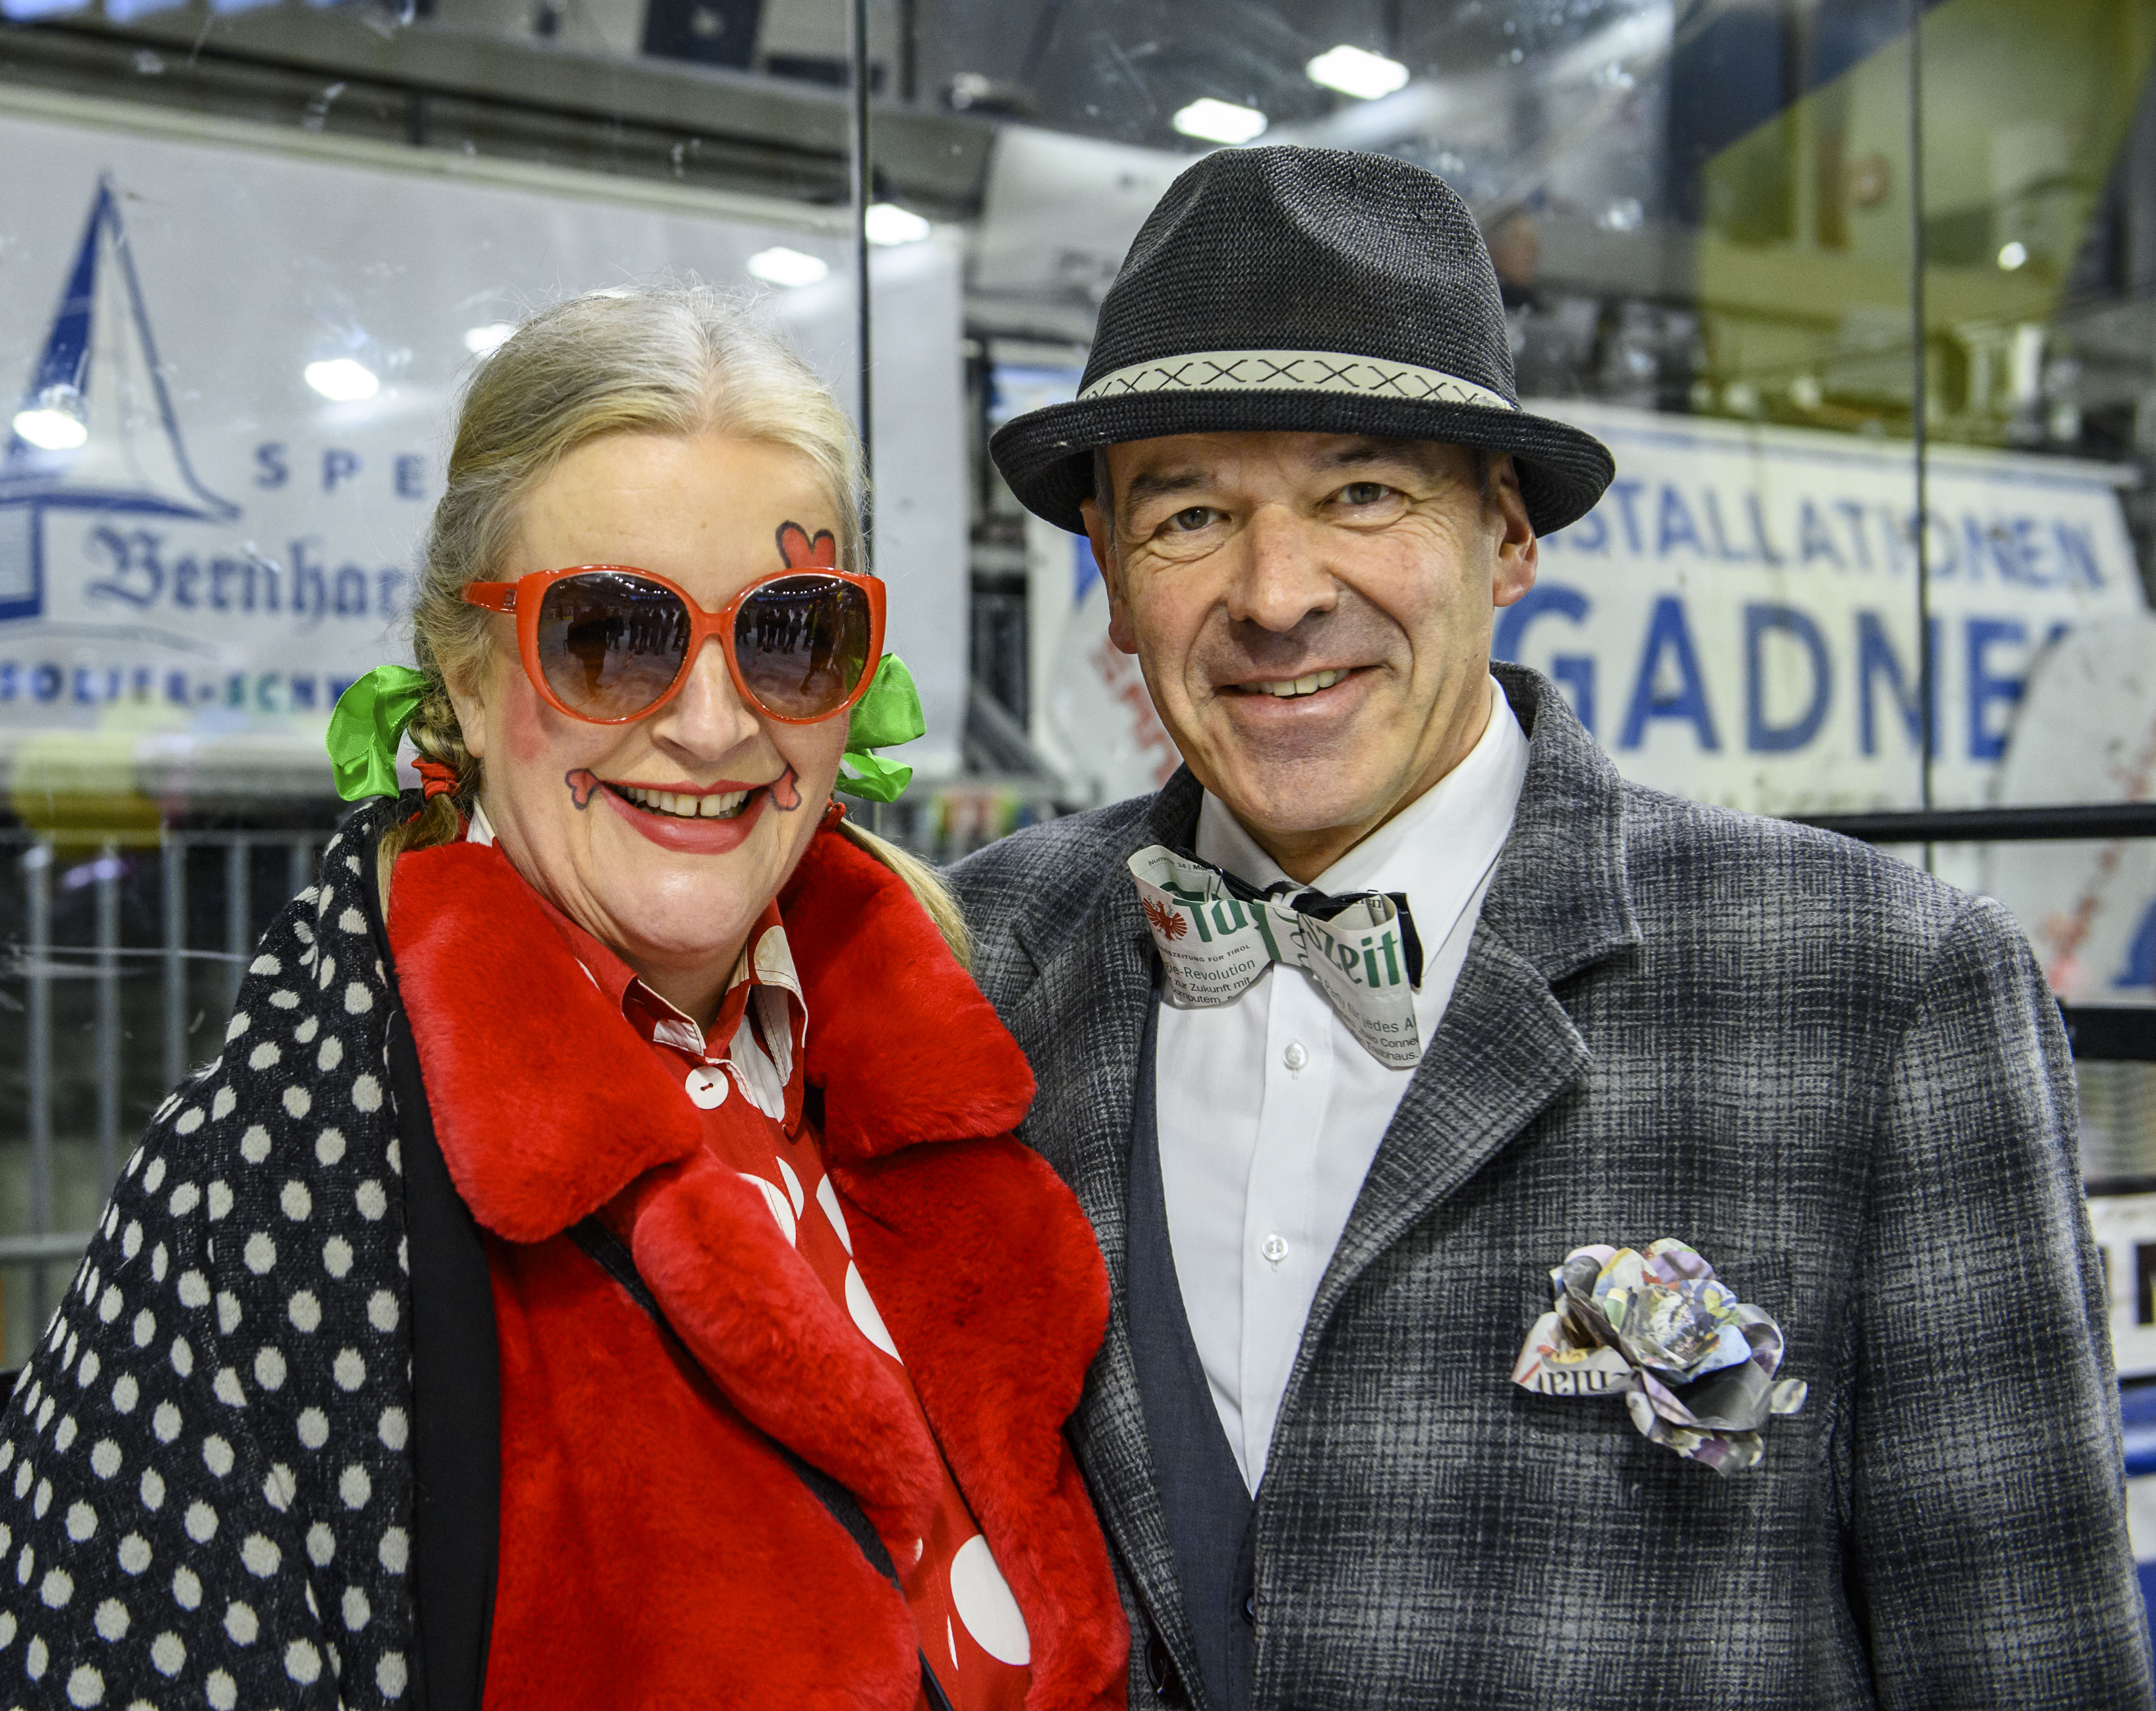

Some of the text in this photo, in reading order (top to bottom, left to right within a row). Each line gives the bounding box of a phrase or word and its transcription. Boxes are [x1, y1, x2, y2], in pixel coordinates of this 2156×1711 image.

[1542, 479, 2106, 590] STALLATIONEN
[1490, 580, 2072, 762] GADNE
[1227, 944, 1250, 957] TIROL
[1174, 977, 1251, 993] zur Zukunft mit
